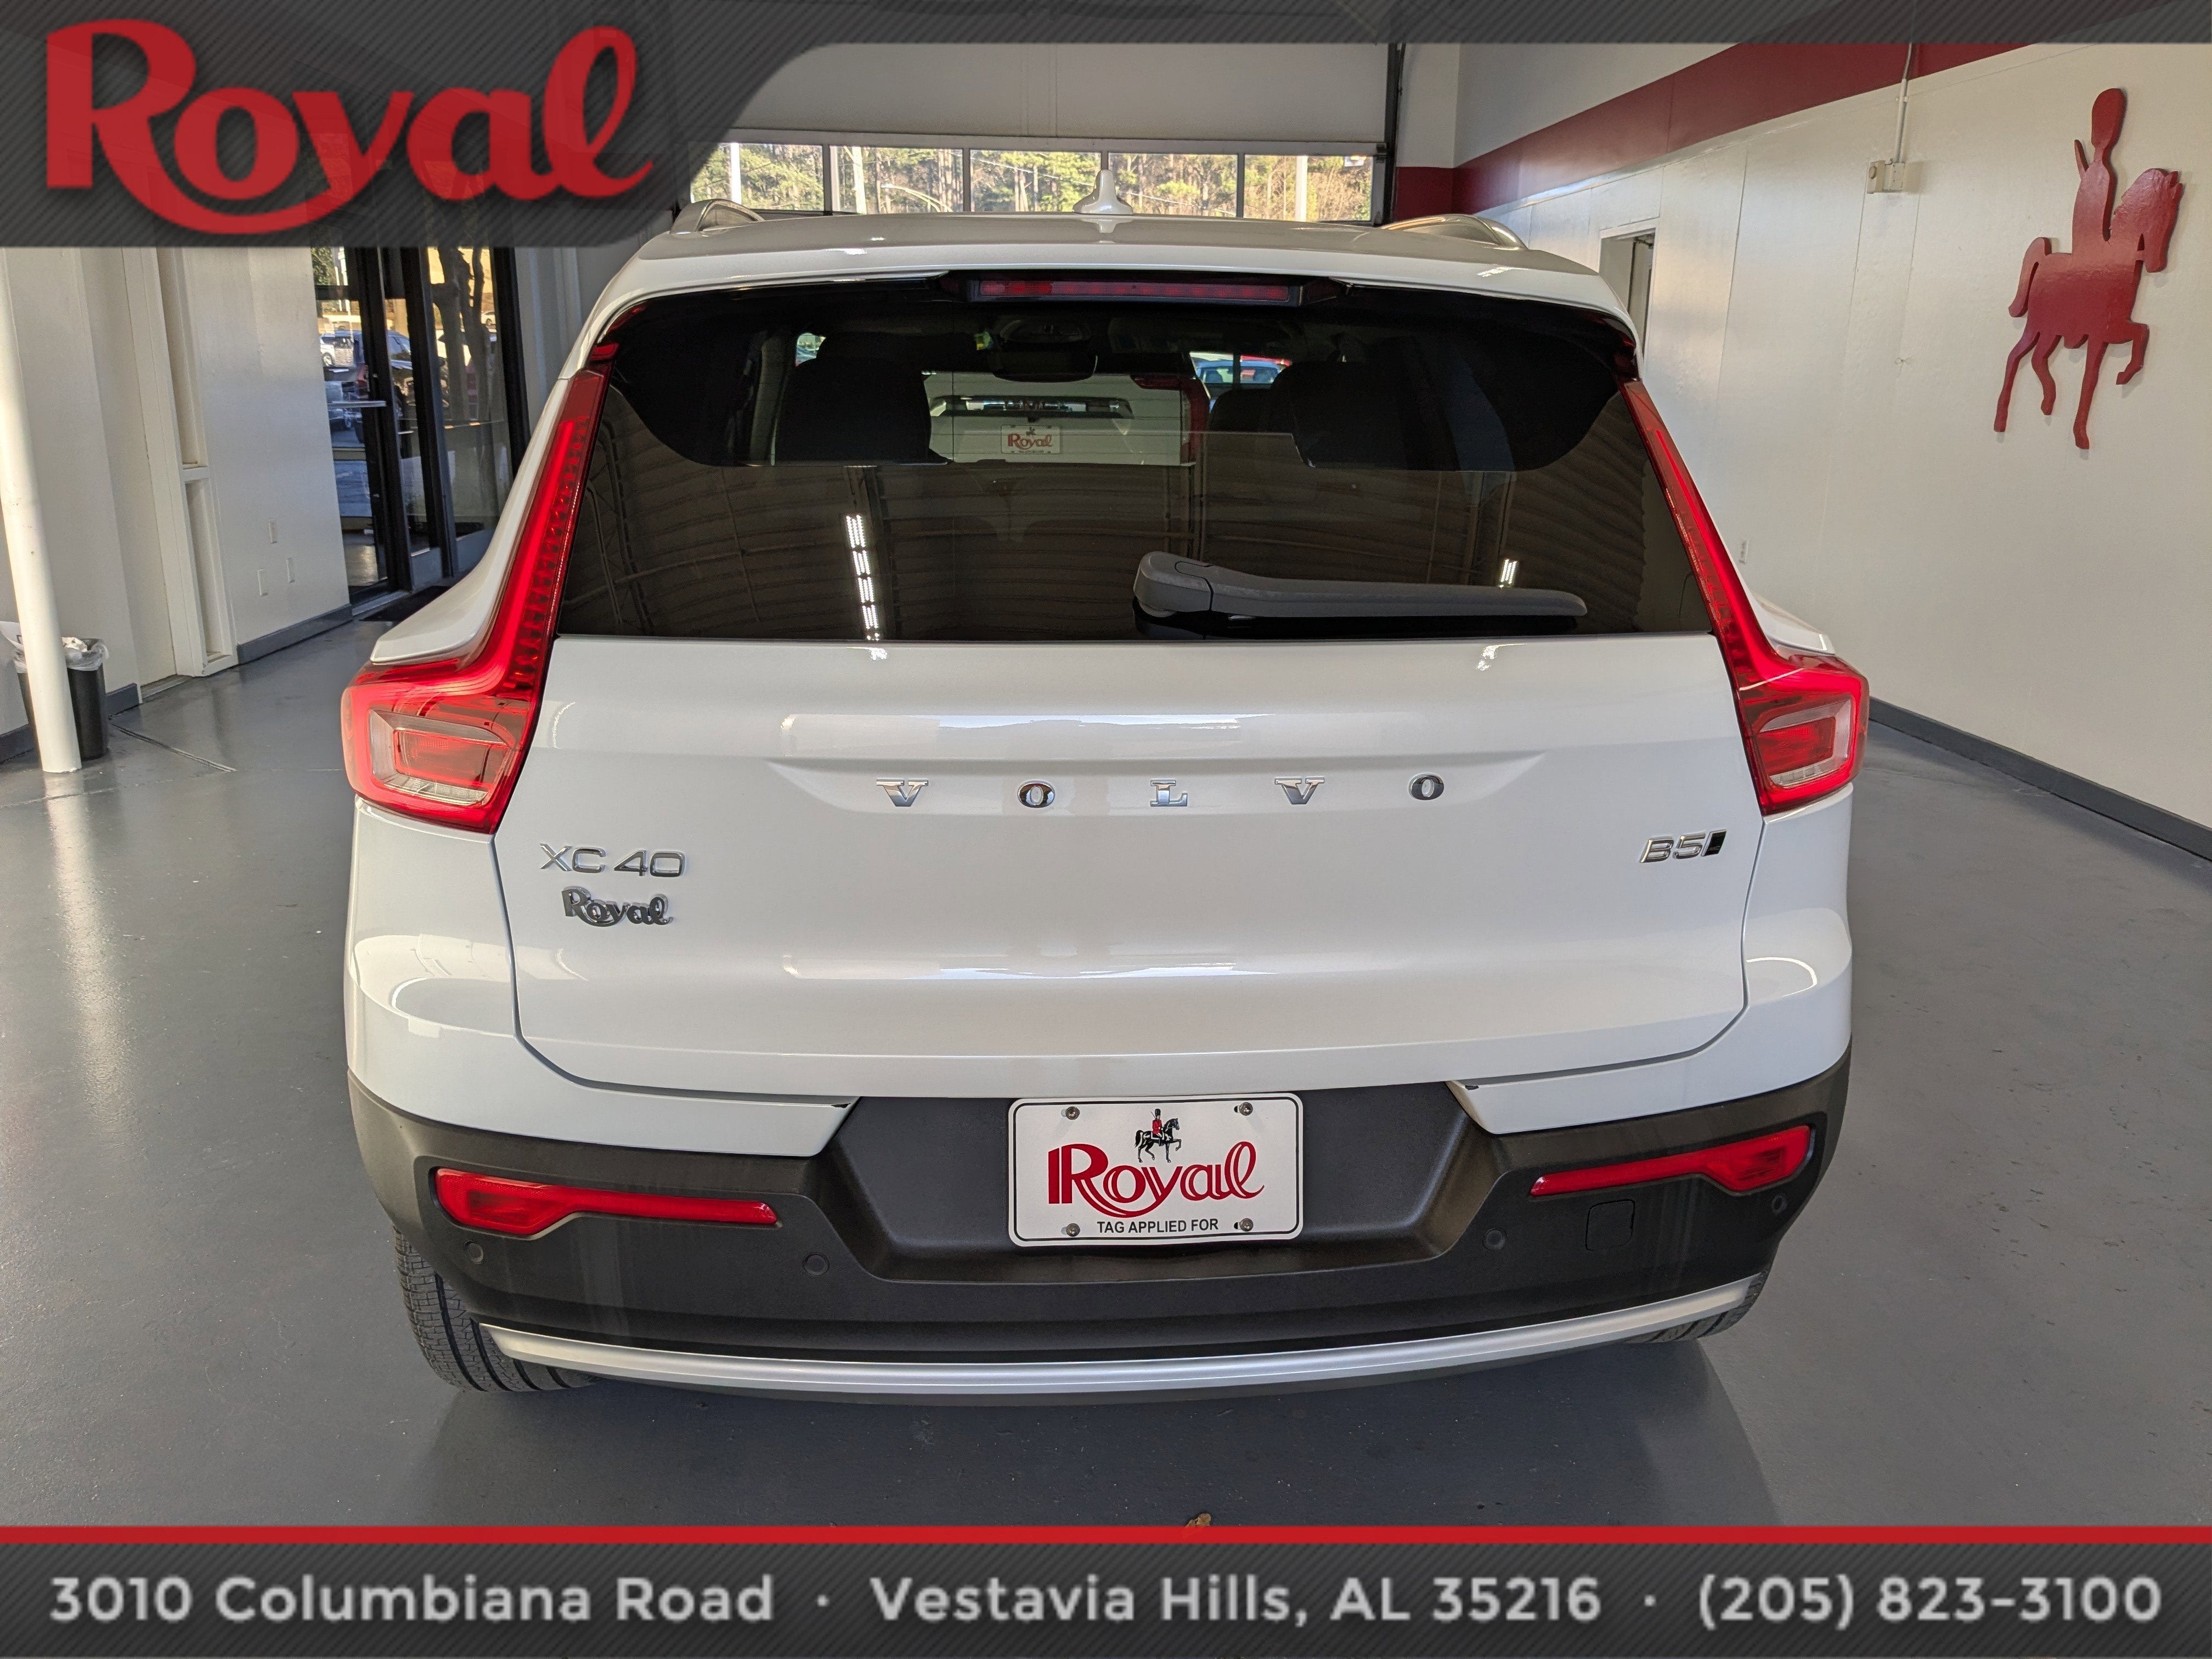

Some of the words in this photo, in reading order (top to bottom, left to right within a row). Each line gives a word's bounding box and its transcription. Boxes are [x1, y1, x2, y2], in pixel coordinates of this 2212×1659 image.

[1008, 433, 1053, 450] Royal
[876, 774, 1445, 809] VOLVO
[561, 885, 674, 927] Royal
[1048, 1141, 1265, 1218] Royal
[1097, 1221, 1125, 1233] TAG
[1128, 1220, 1187, 1233] APPLIED
[1191, 1218, 1218, 1231] FOR
